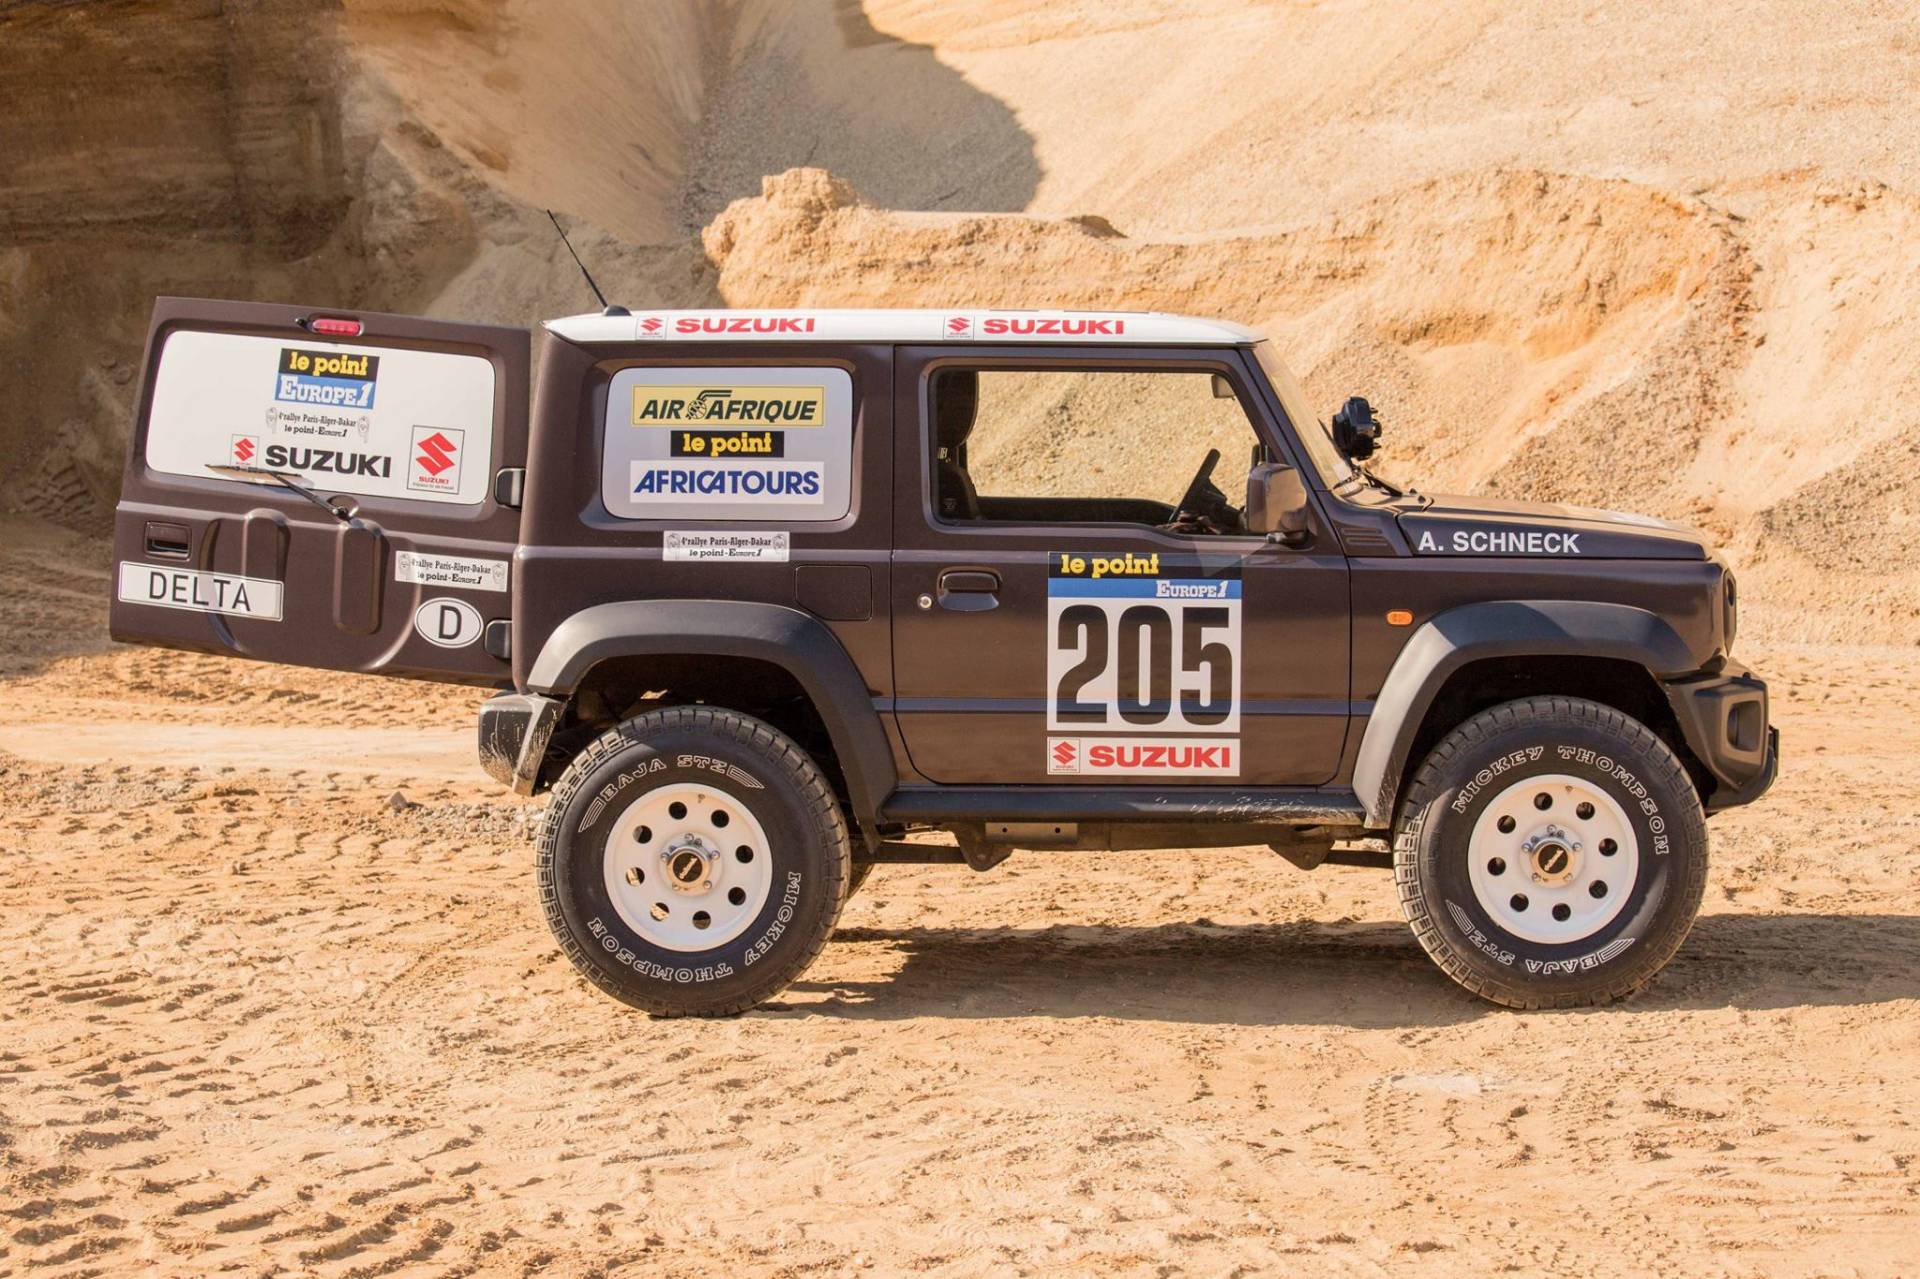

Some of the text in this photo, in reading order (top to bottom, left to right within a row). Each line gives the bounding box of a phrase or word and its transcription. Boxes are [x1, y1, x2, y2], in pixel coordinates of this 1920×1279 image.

[675, 318, 815, 333] SUZUKI
[983, 319, 1124, 335] SUZUKI
[289, 351, 368, 376] le point
[639, 400, 817, 423] AIR AFRIQUE
[683, 432, 772, 457] le point
[265, 445, 392, 478] SUZUKI
[634, 470, 820, 495] AFRICATOURS
[1418, 531, 1581, 553] A. SCHNECK
[1061, 553, 1159, 578] le point
[149, 571, 251, 612] DELTA
[438, 604, 462, 641] D
[1056, 604, 1233, 726] 205
[1089, 746, 1230, 768] SUZUKI
[601, 755, 729, 801] BAJA STZ
[1452, 745, 1669, 854] MICKEY THOMPSON
[587, 872, 801, 983] MICKEY THOMPSON
[1470, 929, 1599, 974] BAJA STZ
